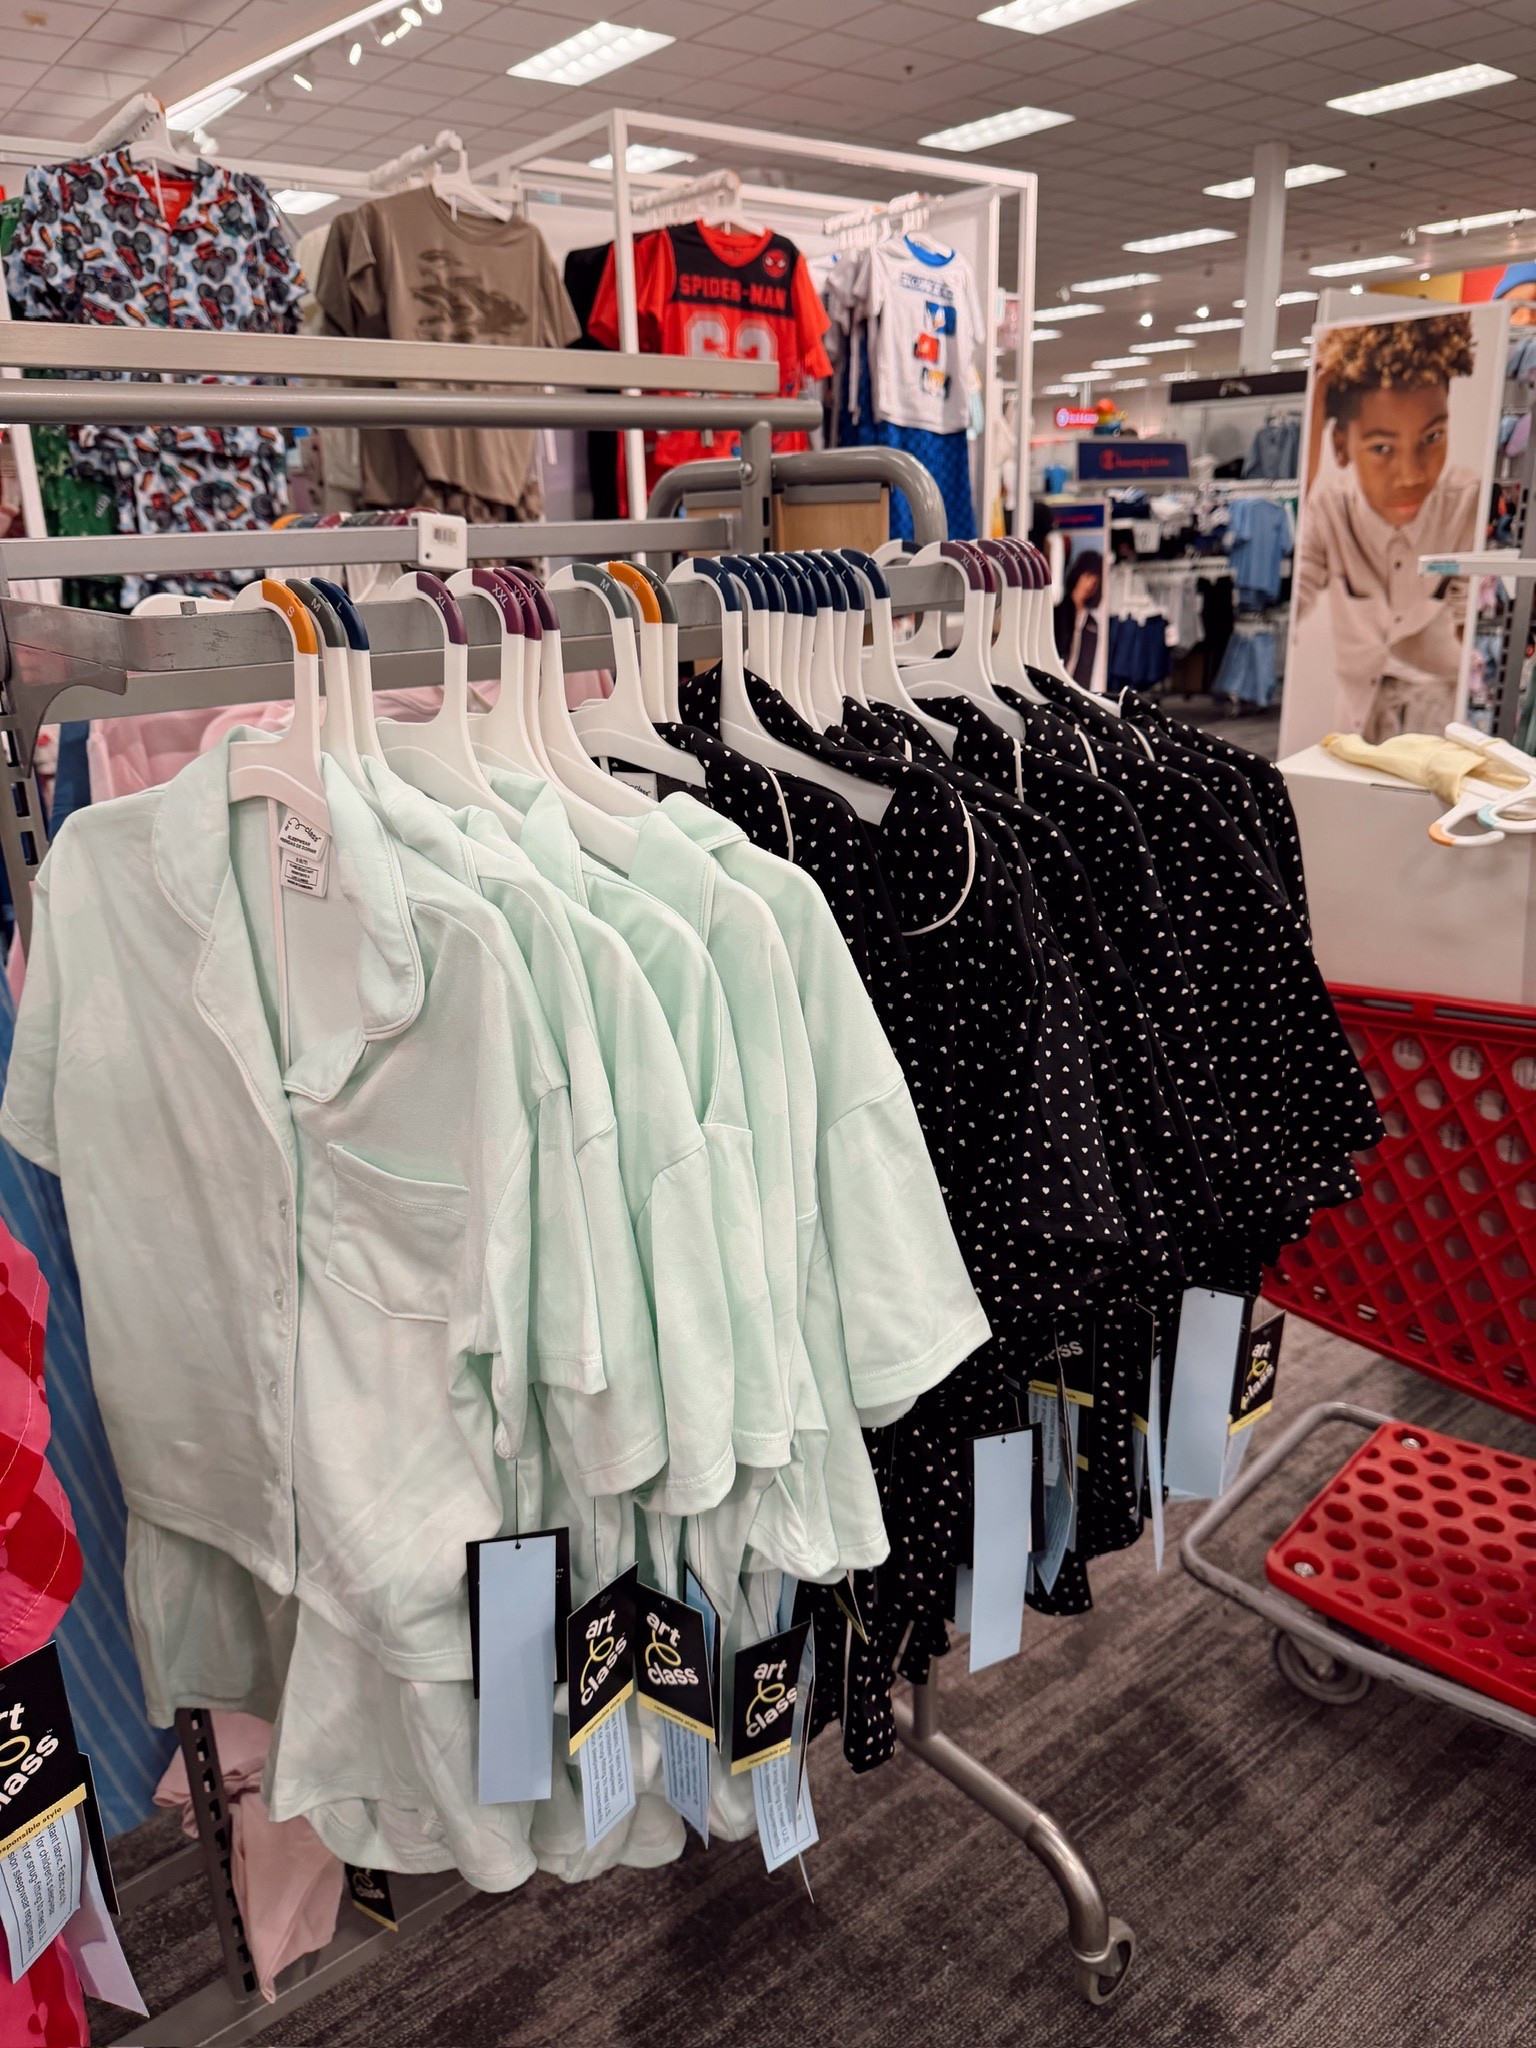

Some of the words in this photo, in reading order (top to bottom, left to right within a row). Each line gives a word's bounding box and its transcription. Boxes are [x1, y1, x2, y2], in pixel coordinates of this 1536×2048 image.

[679, 273, 786, 310] SPIDER-MAN
[961, 554, 970, 569] XL
[599, 578, 610, 592] M
[715, 572, 721, 583] L
[311, 598, 322, 612] M
[435, 591, 446, 611] XL
[492, 582, 509, 609] XXL
[286, 605, 295, 617] S
[336, 602, 342, 613] L
[304, 826, 319, 843] class
[1251, 1341, 1272, 1358] art
[585, 1609, 616, 1640] art
[646, 1611, 681, 1647] art
[580, 1636, 628, 1706] class
[647, 1662, 699, 1686] class
[753, 1659, 788, 1680] art
[746, 1686, 798, 1738] class
[0, 1822, 41, 1854] sponsible
[42, 1807, 62, 1823] style
[47, 1822, 59, 1845] stant
[36, 1835, 45, 1850] for
[7, 1850, 19, 1870] sion
[23, 1850, 33, 1861] or
[39, 1849, 55, 1886] children's
[12, 1868, 30, 1910] sleepwear
[26, 1860, 43, 1906] snug-fitting
